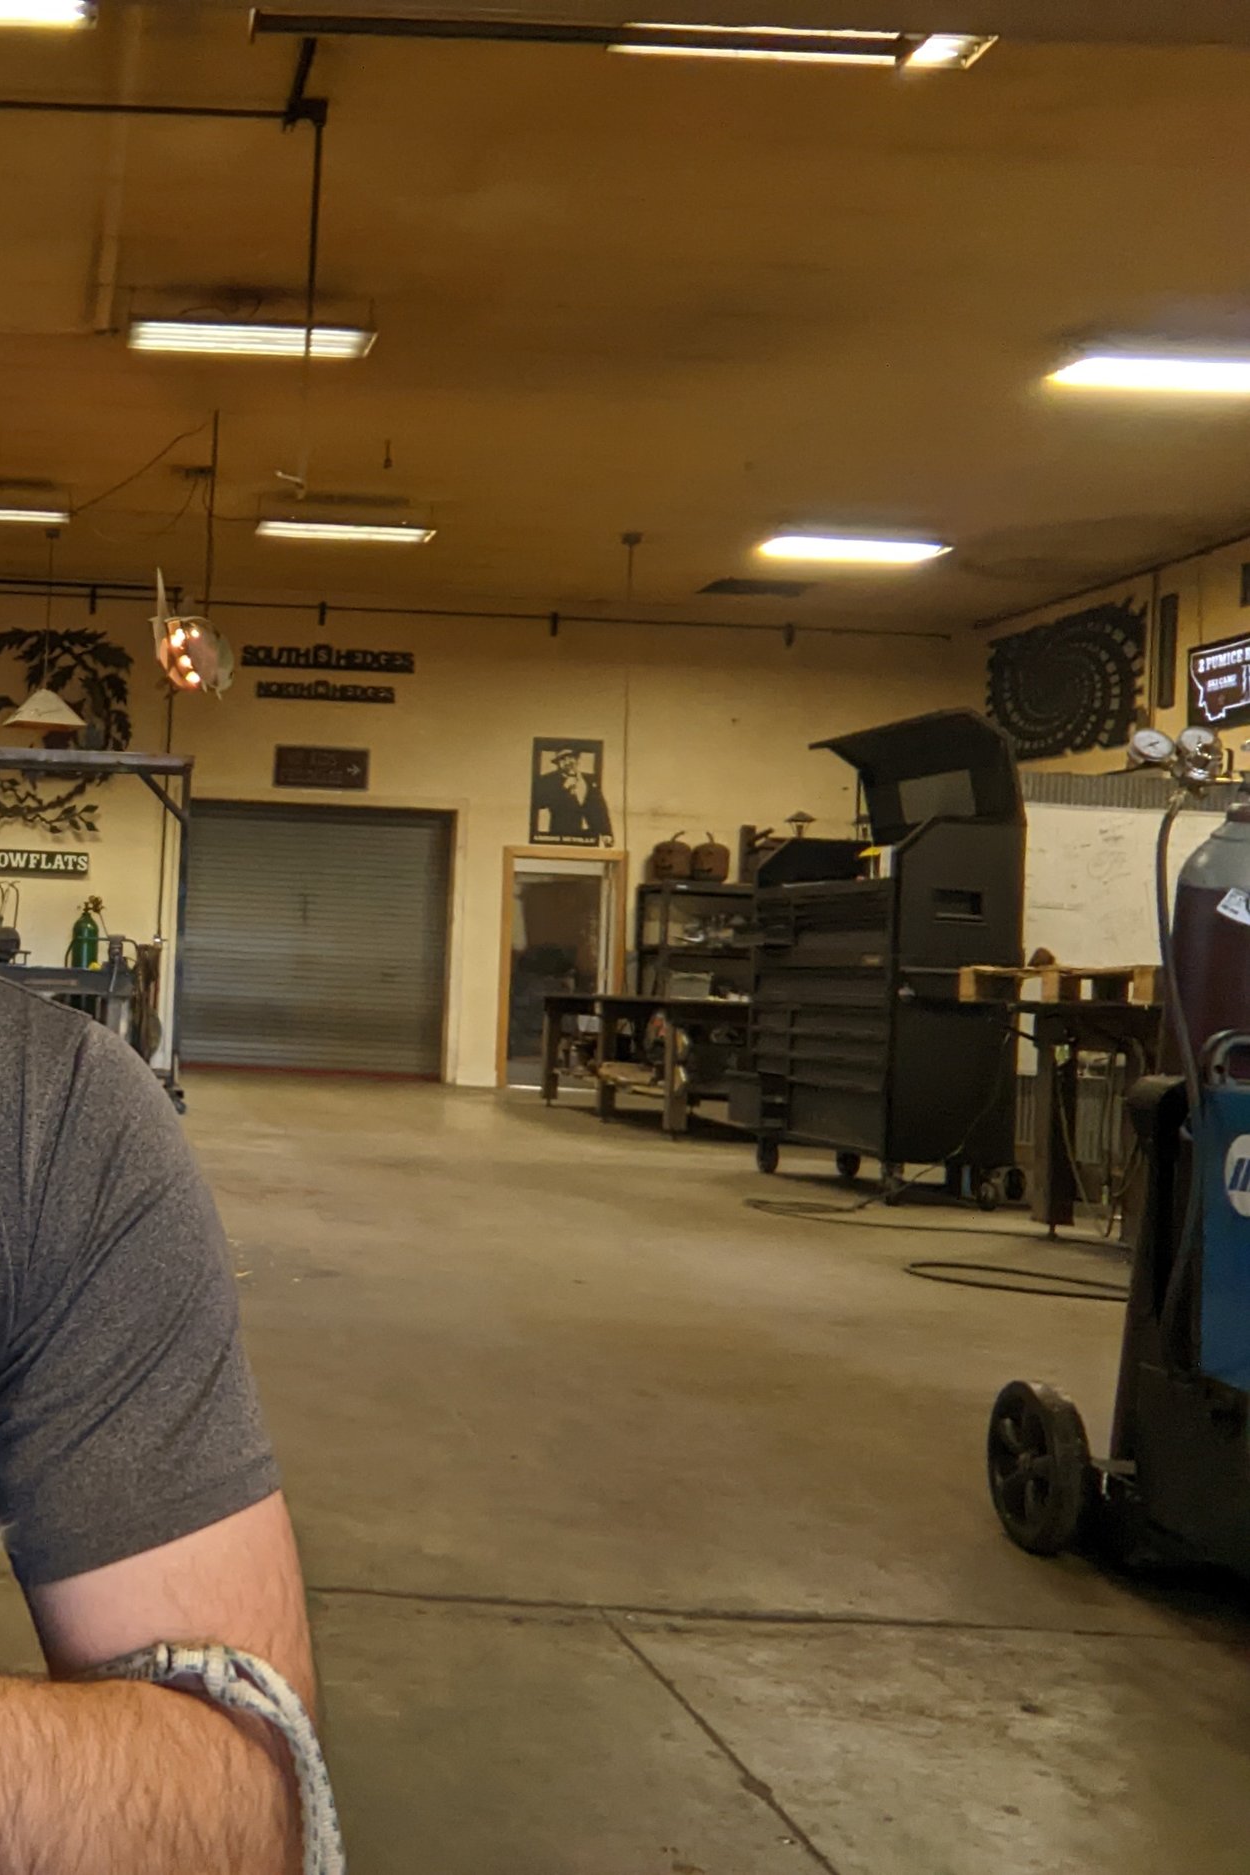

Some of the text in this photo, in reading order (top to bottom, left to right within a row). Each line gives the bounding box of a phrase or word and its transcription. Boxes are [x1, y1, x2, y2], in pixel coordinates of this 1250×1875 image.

[242, 645, 311, 666] SOUTH
[336, 649, 414, 671] HEDGES
[1206, 649, 1243, 671] PUMICE
[257, 681, 312, 697] NORTH
